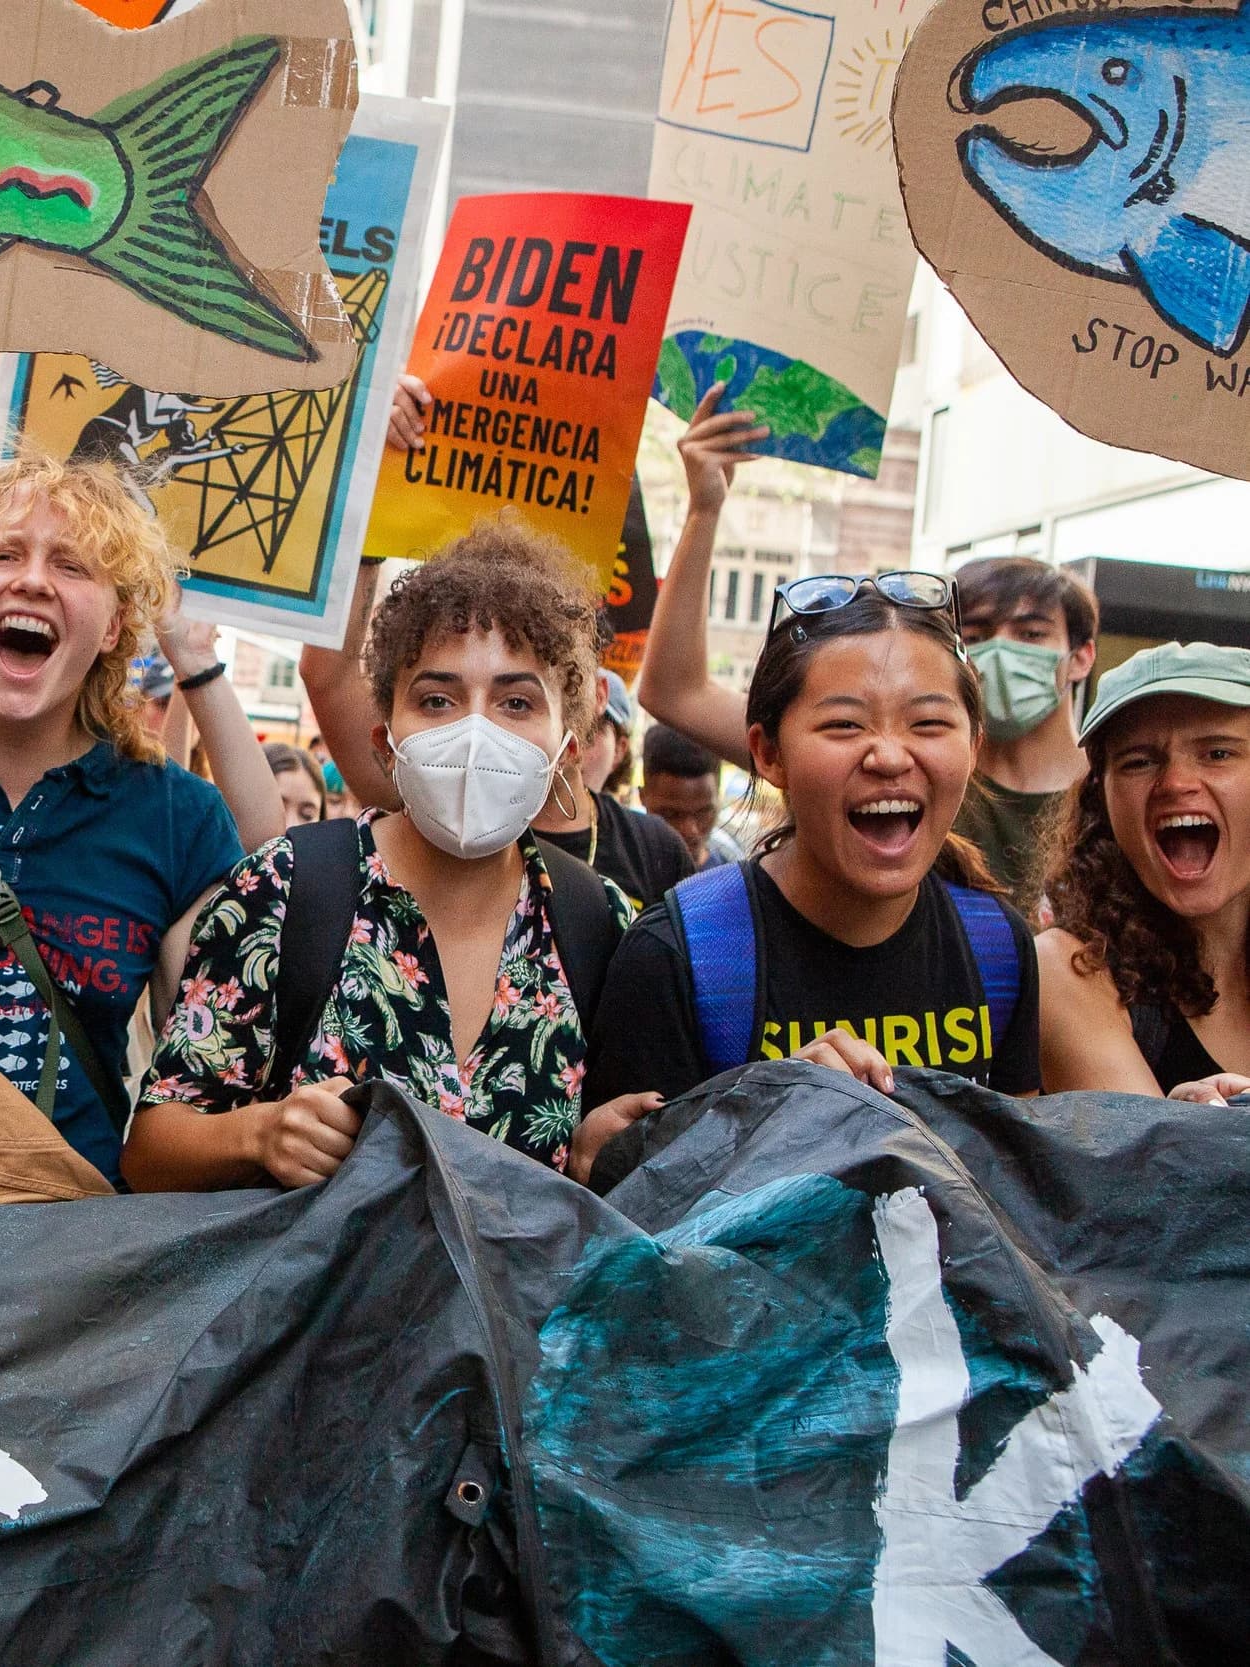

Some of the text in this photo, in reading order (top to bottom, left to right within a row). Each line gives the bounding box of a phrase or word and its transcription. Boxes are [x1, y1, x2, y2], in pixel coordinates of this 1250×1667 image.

[670, 0, 808, 121] YES
[672, 142, 903, 245] CLIMATE
[319, 215, 395, 264] ELS
[450, 237, 644, 325] BIDEN
[689, 224, 900, 333] USTICE
[432, 311, 617, 381] ¡DECLARA
[1072, 317, 1180, 379] STOP
[479, 369, 538, 406] UNA
[404, 445, 595, 515] CLIMÁTICA!
[126, 920, 154, 955] IS
[760, 1004, 992, 1067] SNRIS
